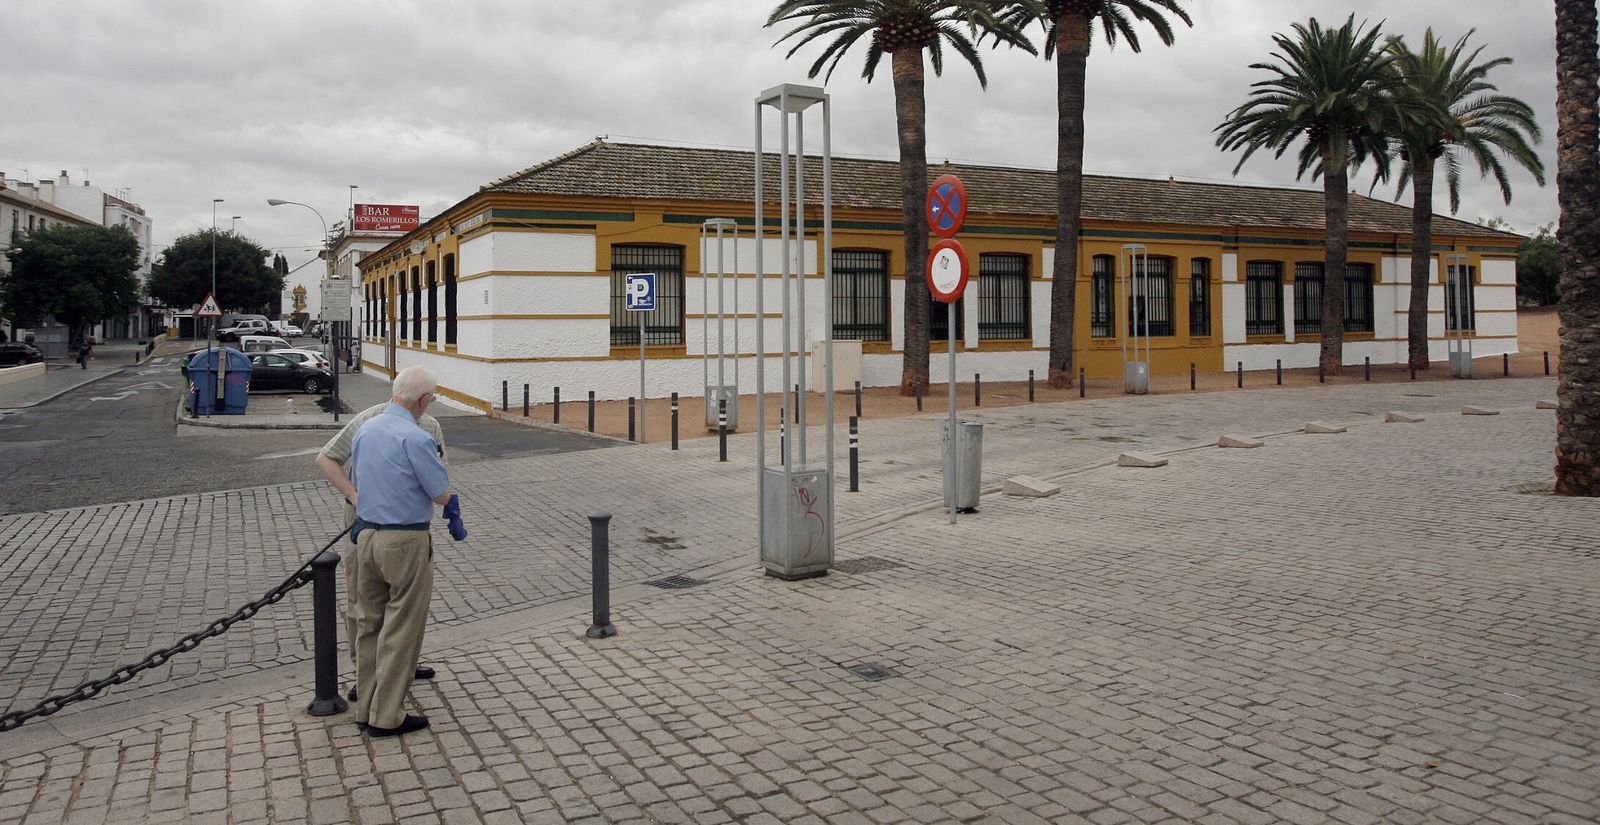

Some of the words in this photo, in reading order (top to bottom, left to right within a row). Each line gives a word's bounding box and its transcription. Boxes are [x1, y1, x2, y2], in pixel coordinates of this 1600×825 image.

[368, 207, 390, 215] BAR
[371, 216, 418, 224] ROMERILLOS
[632, 278, 649, 306] P
